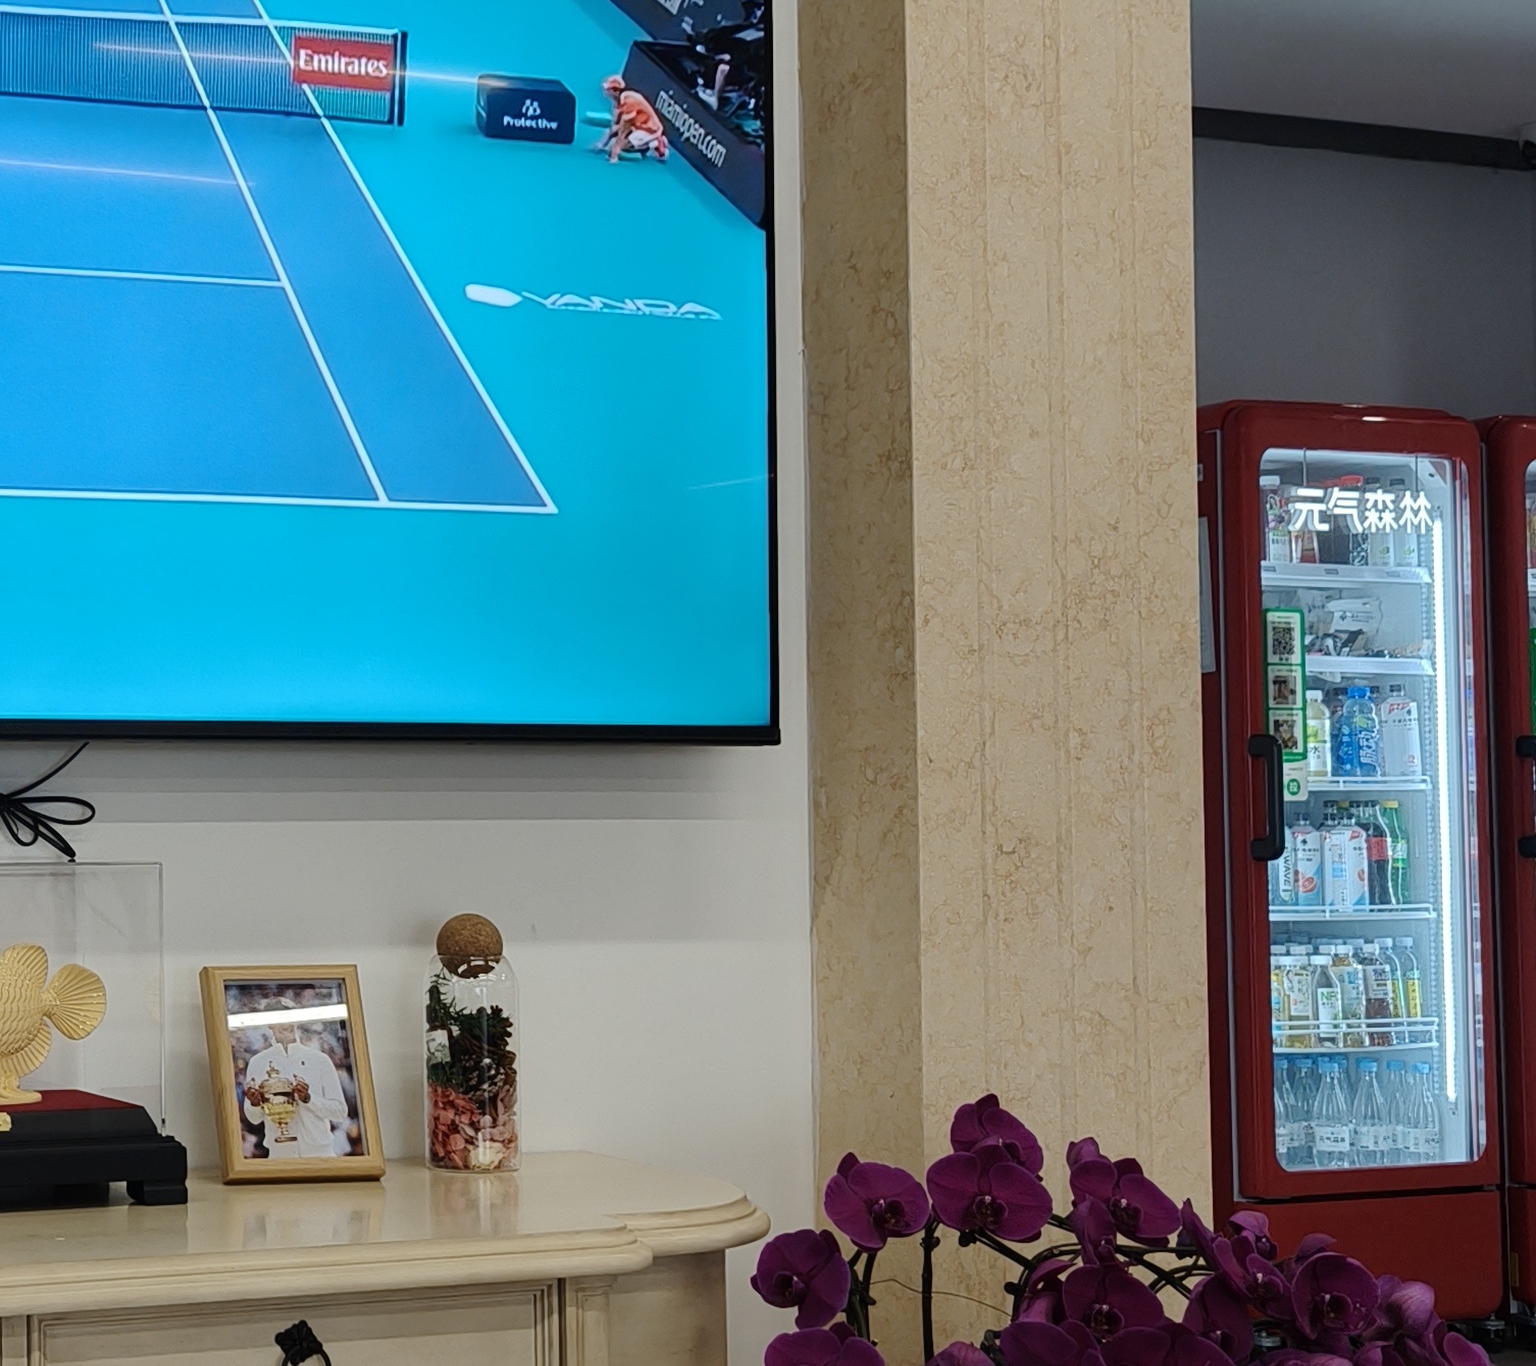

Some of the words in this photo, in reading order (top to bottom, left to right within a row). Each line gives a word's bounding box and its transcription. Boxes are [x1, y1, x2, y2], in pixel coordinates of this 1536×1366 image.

[298, 48, 389, 78] Emirates
[503, 114, 559, 131] Protective
[1291, 487, 1433, 534] 元气森林
